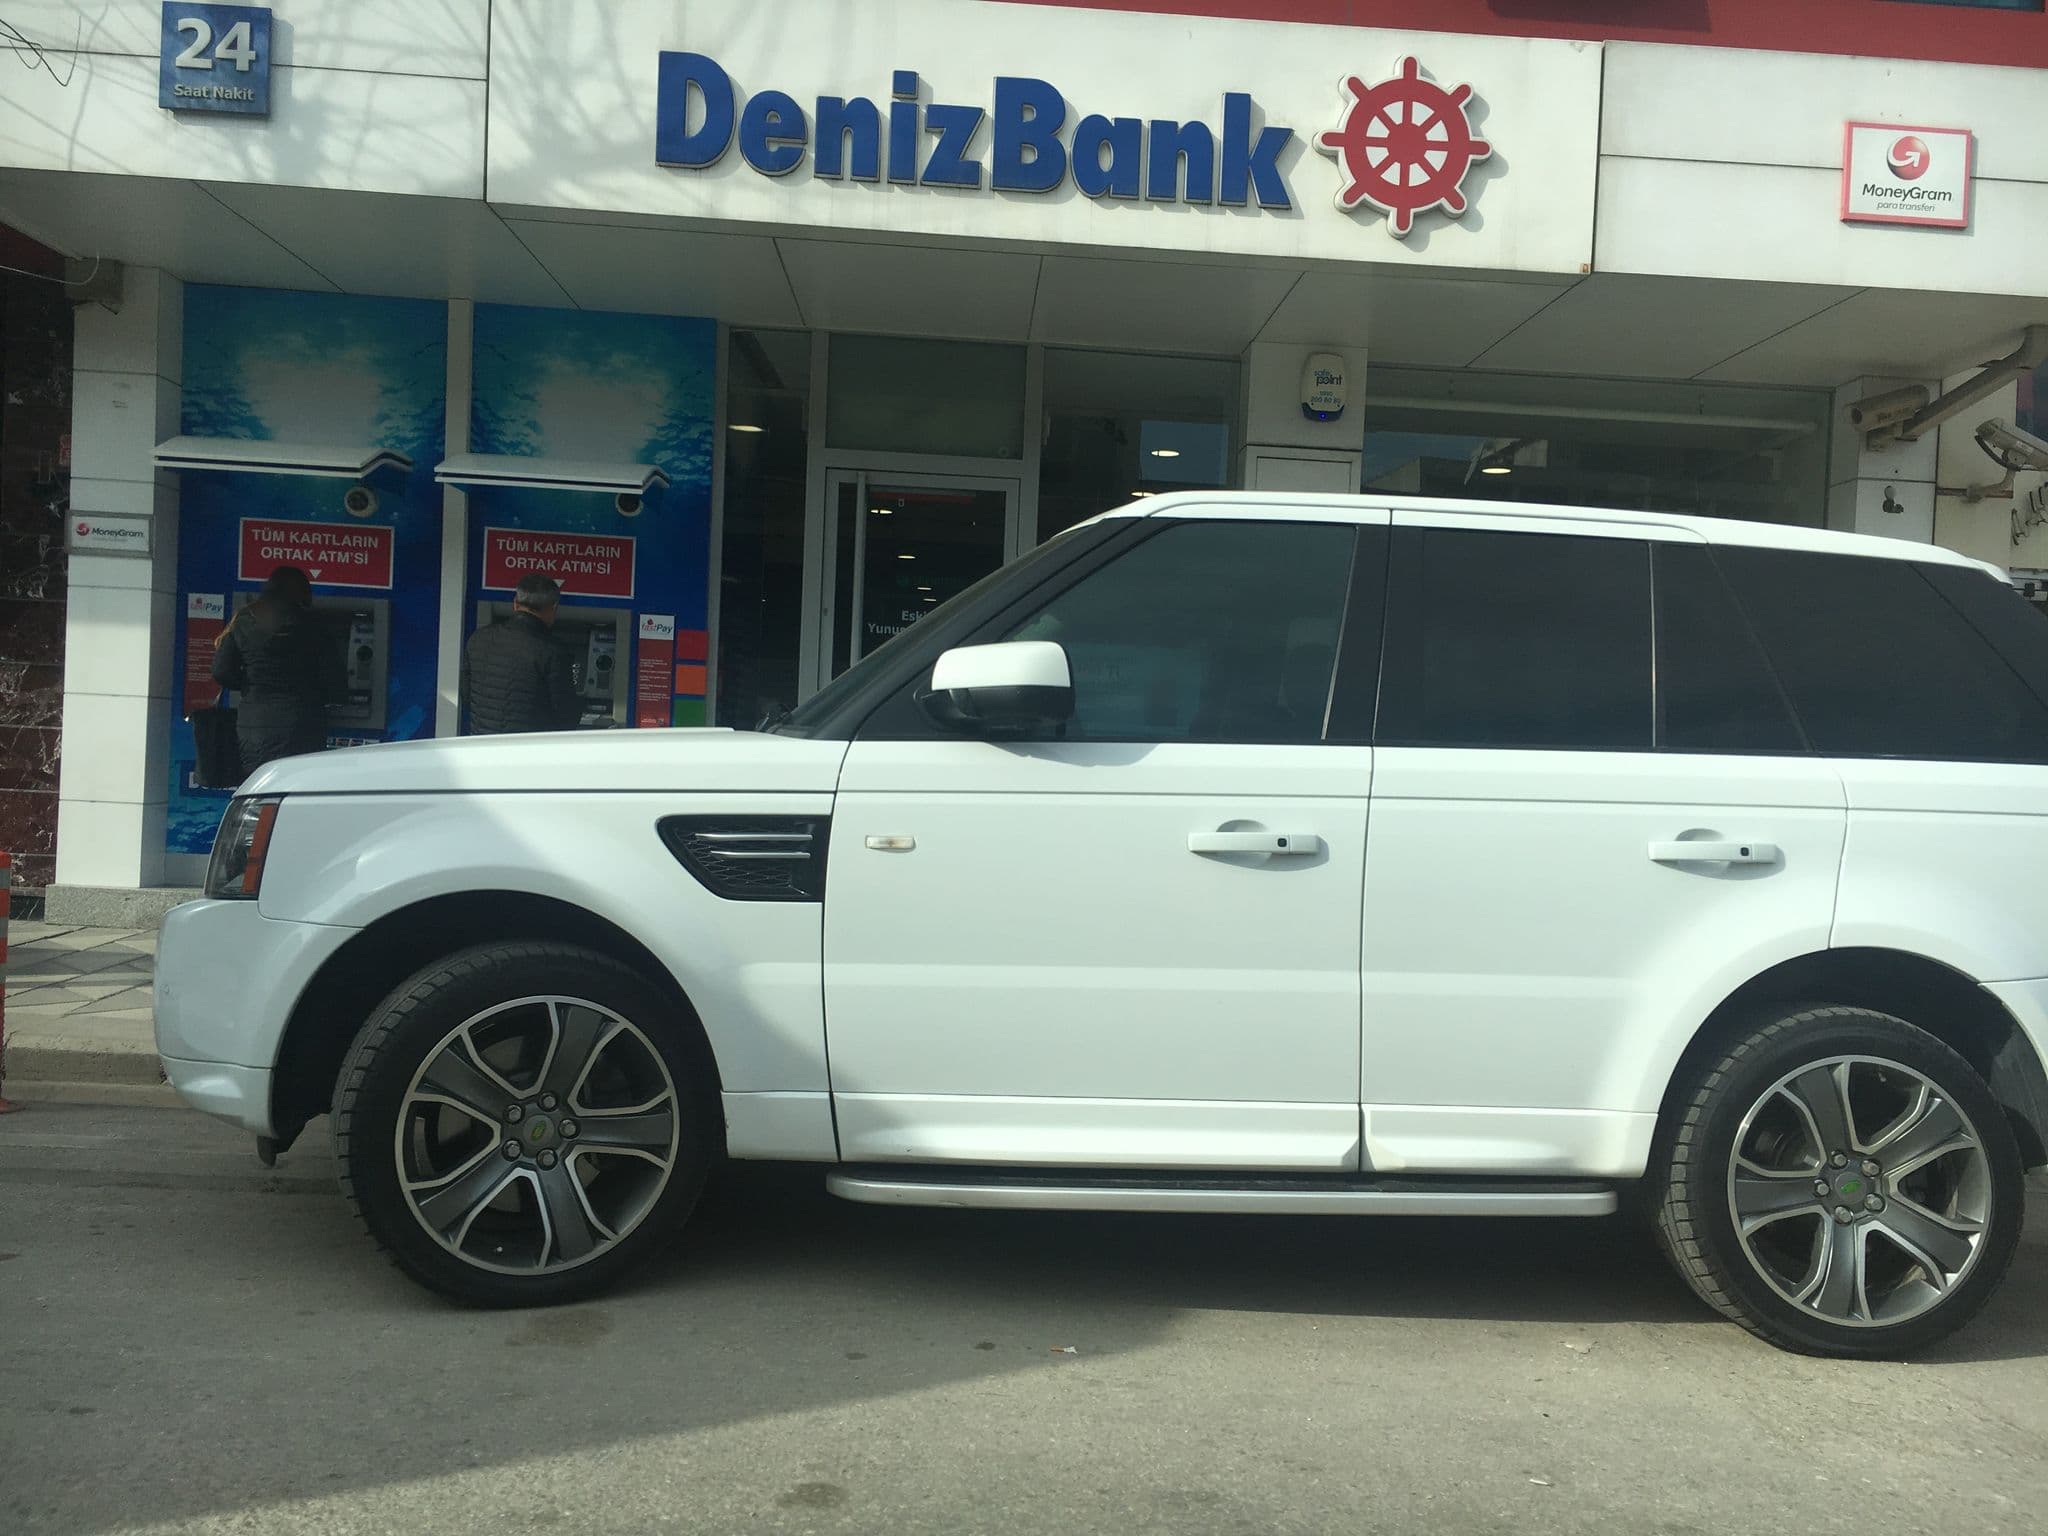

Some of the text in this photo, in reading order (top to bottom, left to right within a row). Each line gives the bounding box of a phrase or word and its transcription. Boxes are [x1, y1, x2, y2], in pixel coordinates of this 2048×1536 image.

[175, 17, 256, 72] 24
[174, 83, 254, 101] Saat Nakit
[655, 50, 1295, 209] DenizBank
[1862, 183, 1952, 201] MoneyGram
[1876, 201, 1898, 210] para
[1316, 374, 1343, 387] point
[91, 527, 144, 538] MoneyGram
[251, 527, 379, 548] TÜM KARTLARIN
[260, 547, 369, 565] ORTAK ATM'Sİ
[496, 537, 621, 559] TÜM KARTLARIN
[505, 556, 611, 576] ORTAK ATM'Sİ
